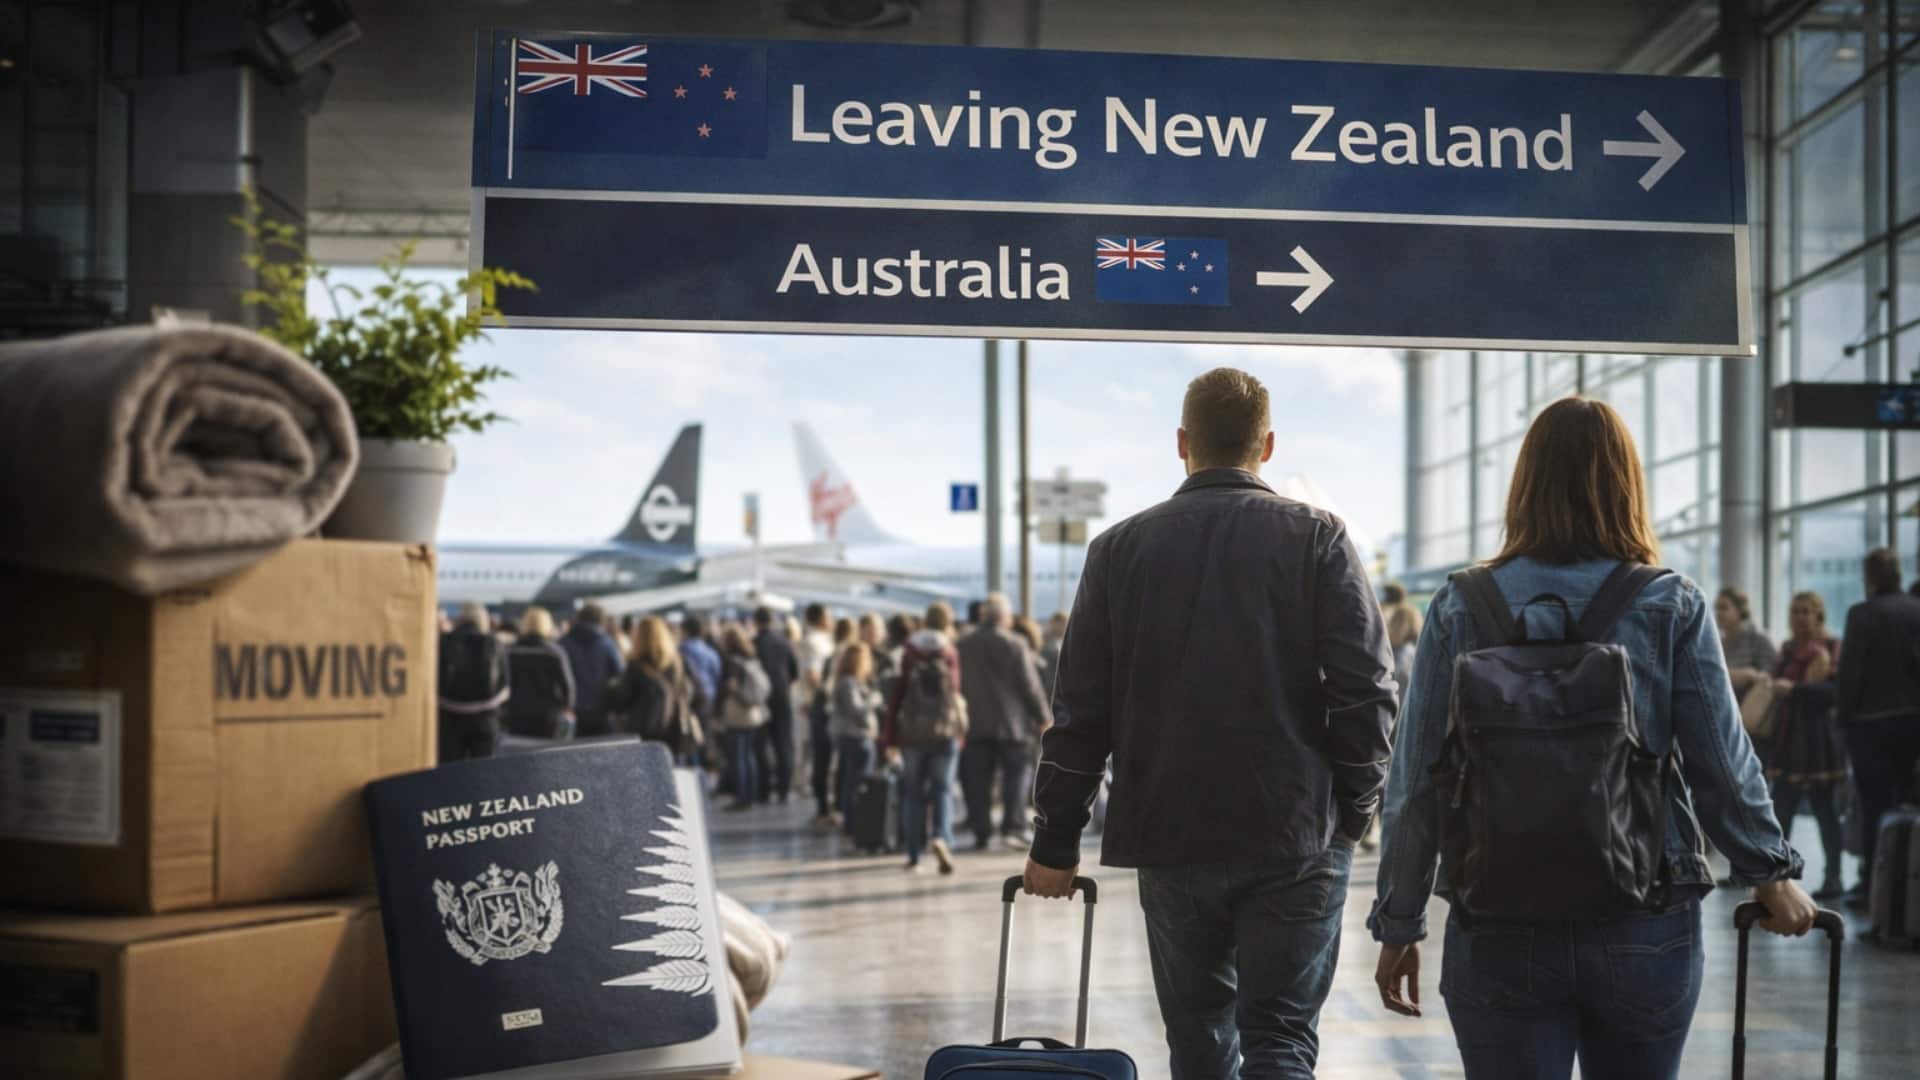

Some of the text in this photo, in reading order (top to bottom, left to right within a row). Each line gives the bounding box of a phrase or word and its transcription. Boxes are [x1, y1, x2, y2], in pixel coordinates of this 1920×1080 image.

[791, 84, 1573, 171] Leaving New Zealand
[775, 243, 1071, 301] Australia
[214, 642, 407, 702] MOVING
[421, 787, 585, 826] NEW ZEALAND
[425, 817, 536, 850] PASSPORT
